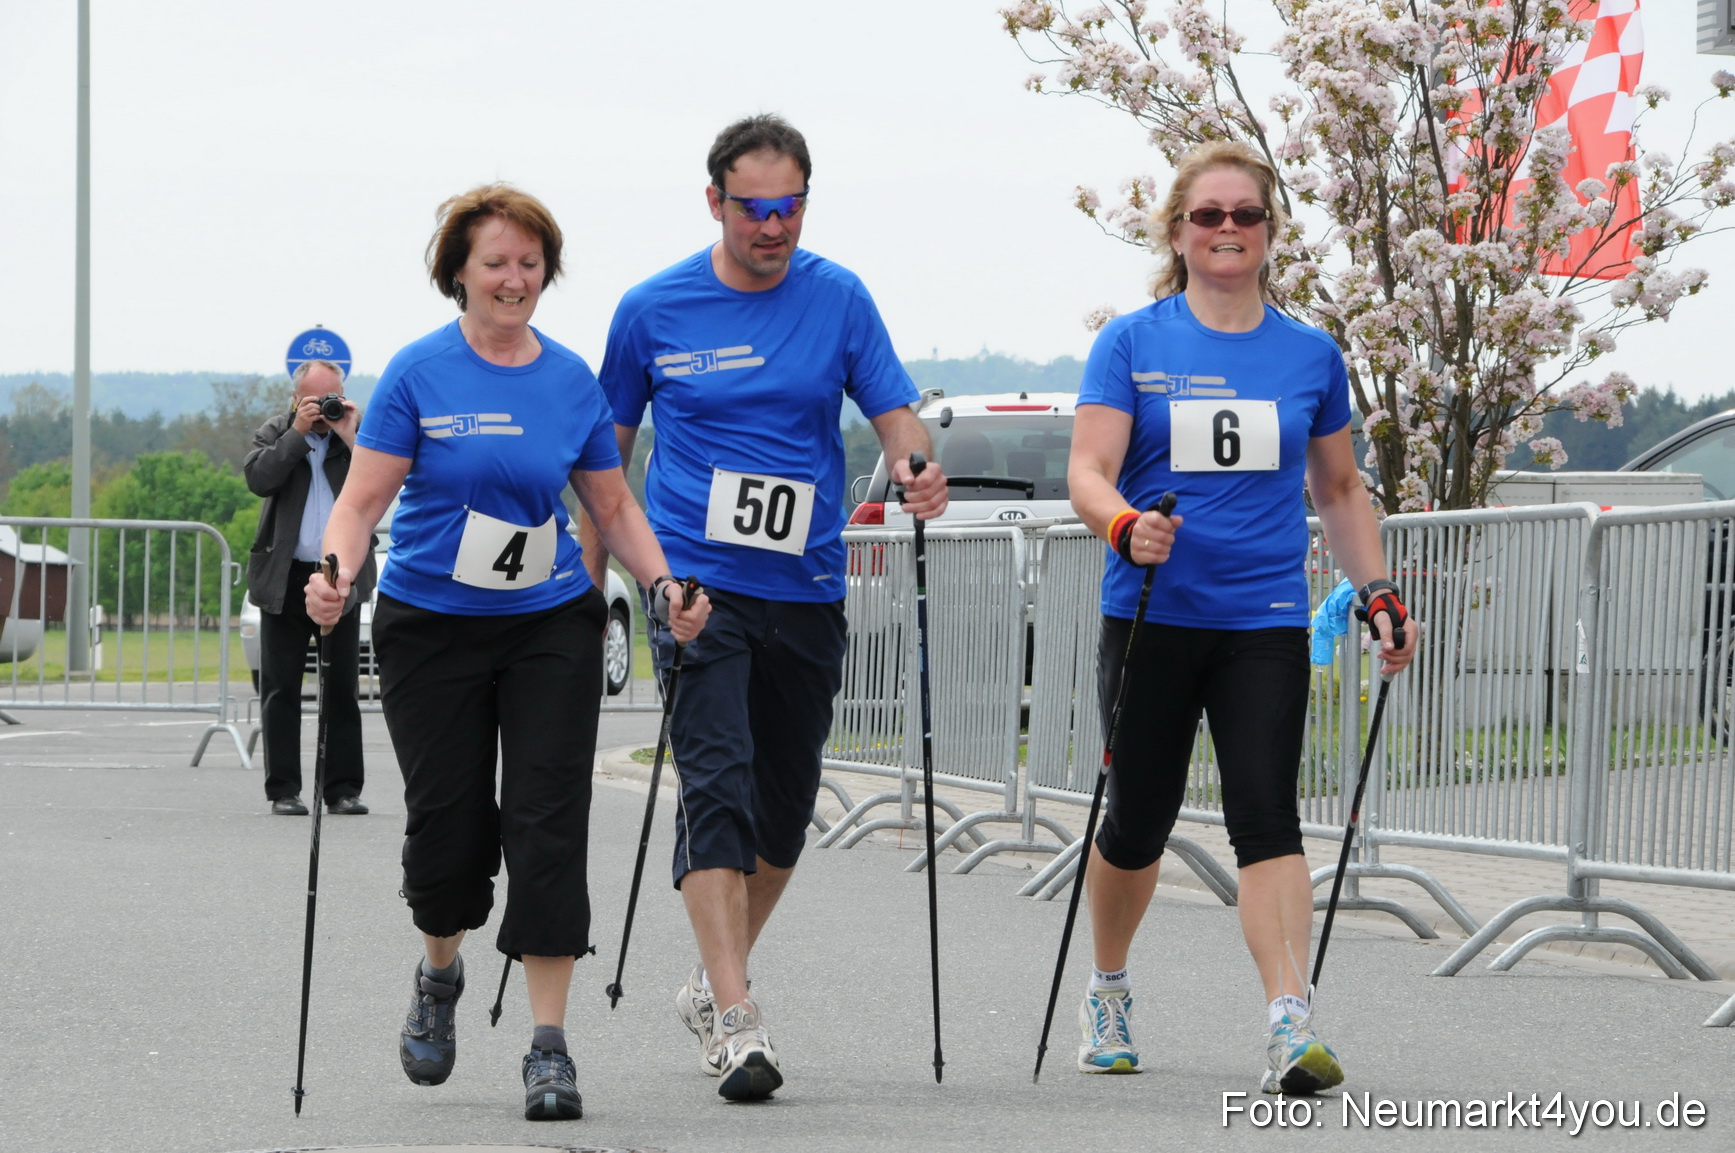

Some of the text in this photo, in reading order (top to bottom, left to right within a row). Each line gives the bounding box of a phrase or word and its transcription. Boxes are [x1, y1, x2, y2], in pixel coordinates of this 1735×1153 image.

[1212, 410, 1241, 467] 6
[734, 475, 797, 541] 50
[1002, 512, 1023, 521] KIA
[492, 531, 529, 581] 4
